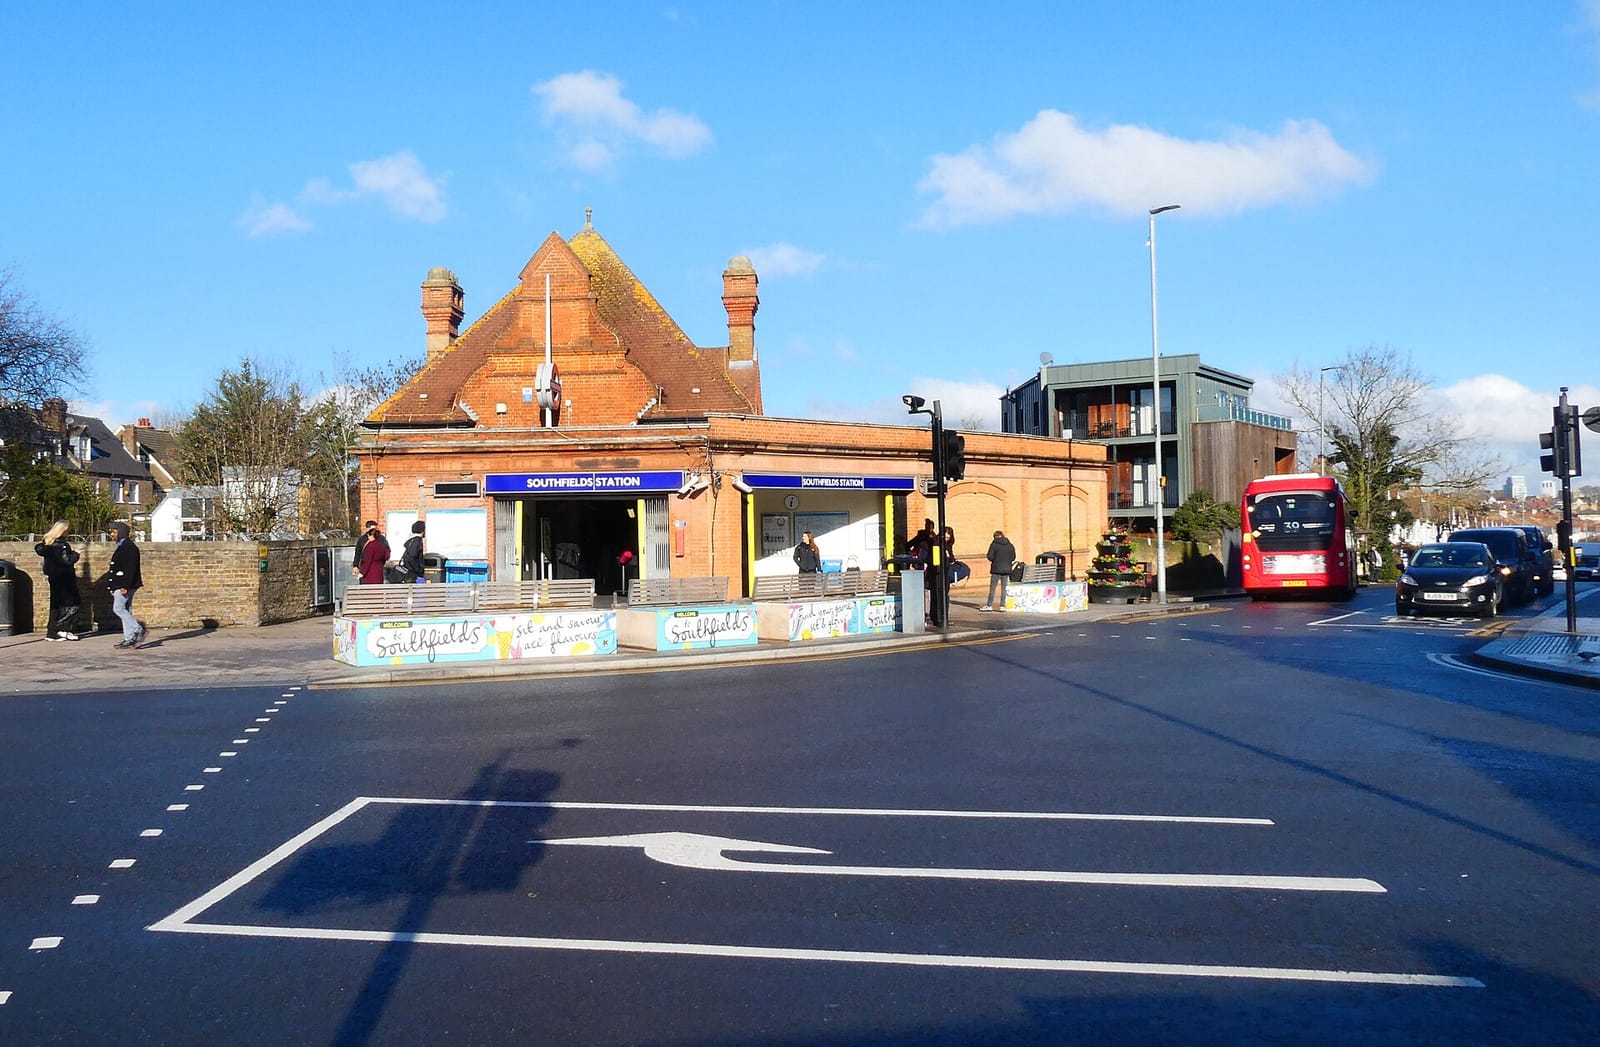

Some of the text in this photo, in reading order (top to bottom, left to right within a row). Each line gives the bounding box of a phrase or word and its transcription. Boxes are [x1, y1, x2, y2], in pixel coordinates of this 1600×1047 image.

[526, 476, 641, 488] SOUTHFIELDS STATION
[802, 477, 864, 487] SOUTHFIELDS STATION
[539, 615, 565, 634] and
[671, 609, 749, 648] Southfields
[375, 619, 481, 663] Southfields
[550, 631, 598, 655] flavours
